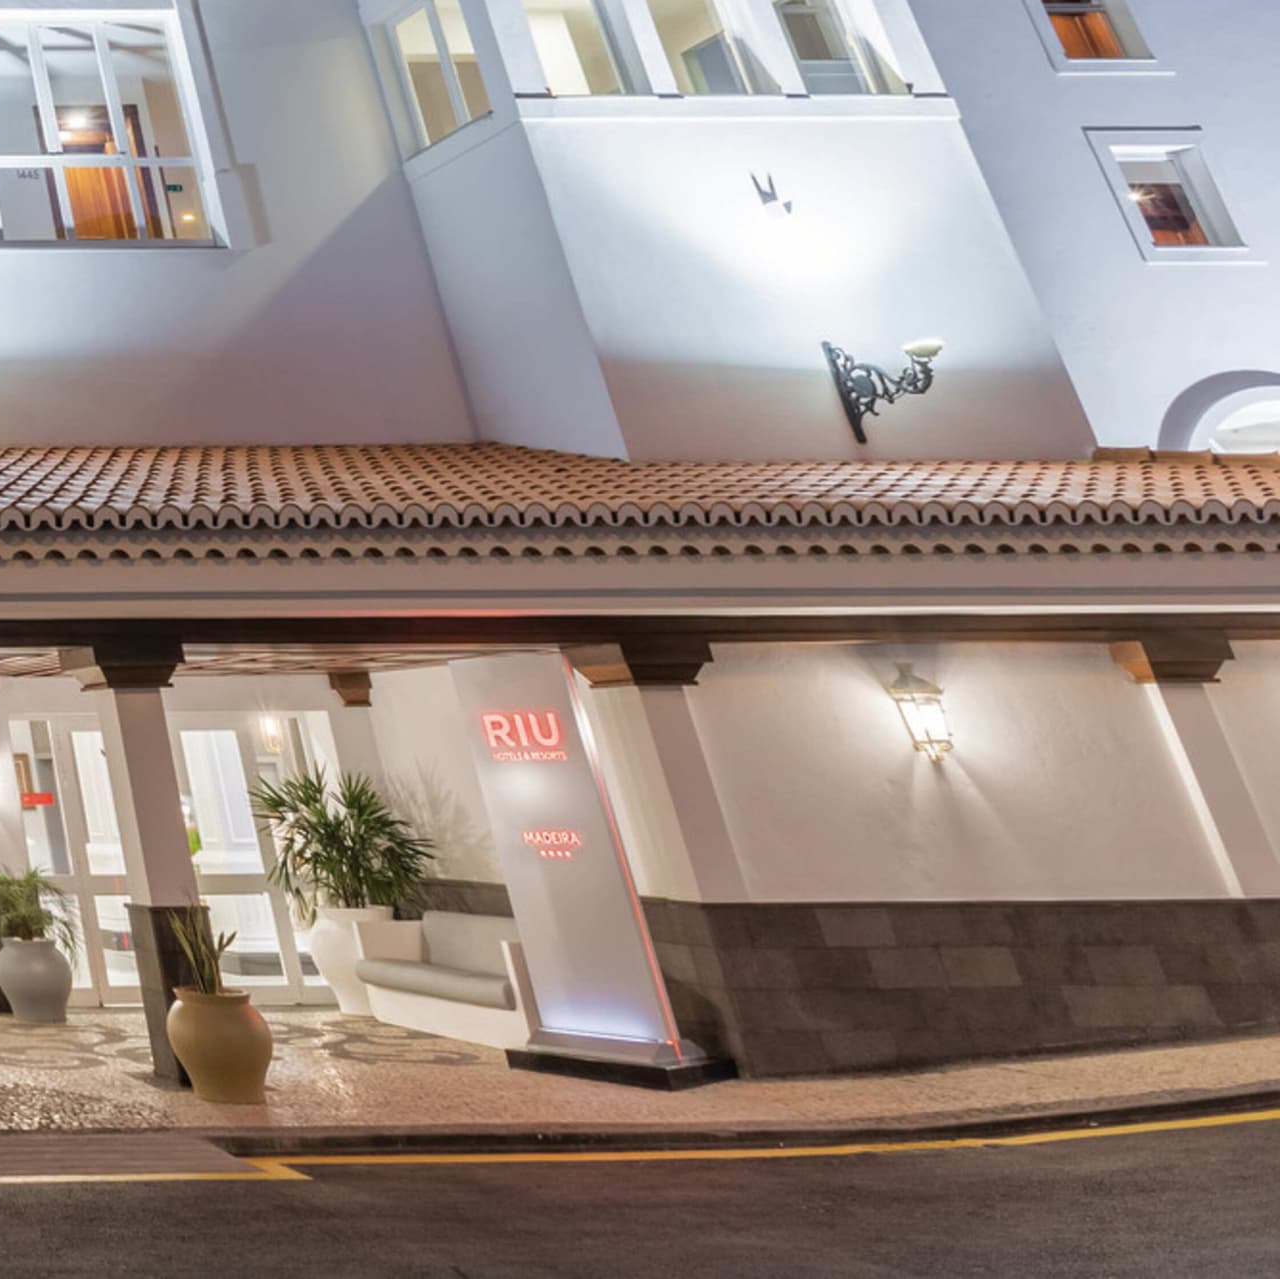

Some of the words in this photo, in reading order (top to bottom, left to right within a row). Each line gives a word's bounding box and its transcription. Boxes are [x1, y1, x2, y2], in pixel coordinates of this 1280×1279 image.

[16, 169, 40, 180] 1445
[482, 712, 560, 748] RIU
[492, 751, 522, 762] HOTELS
[530, 751, 568, 761] RESORTS
[522, 831, 582, 846] MADEIRA
